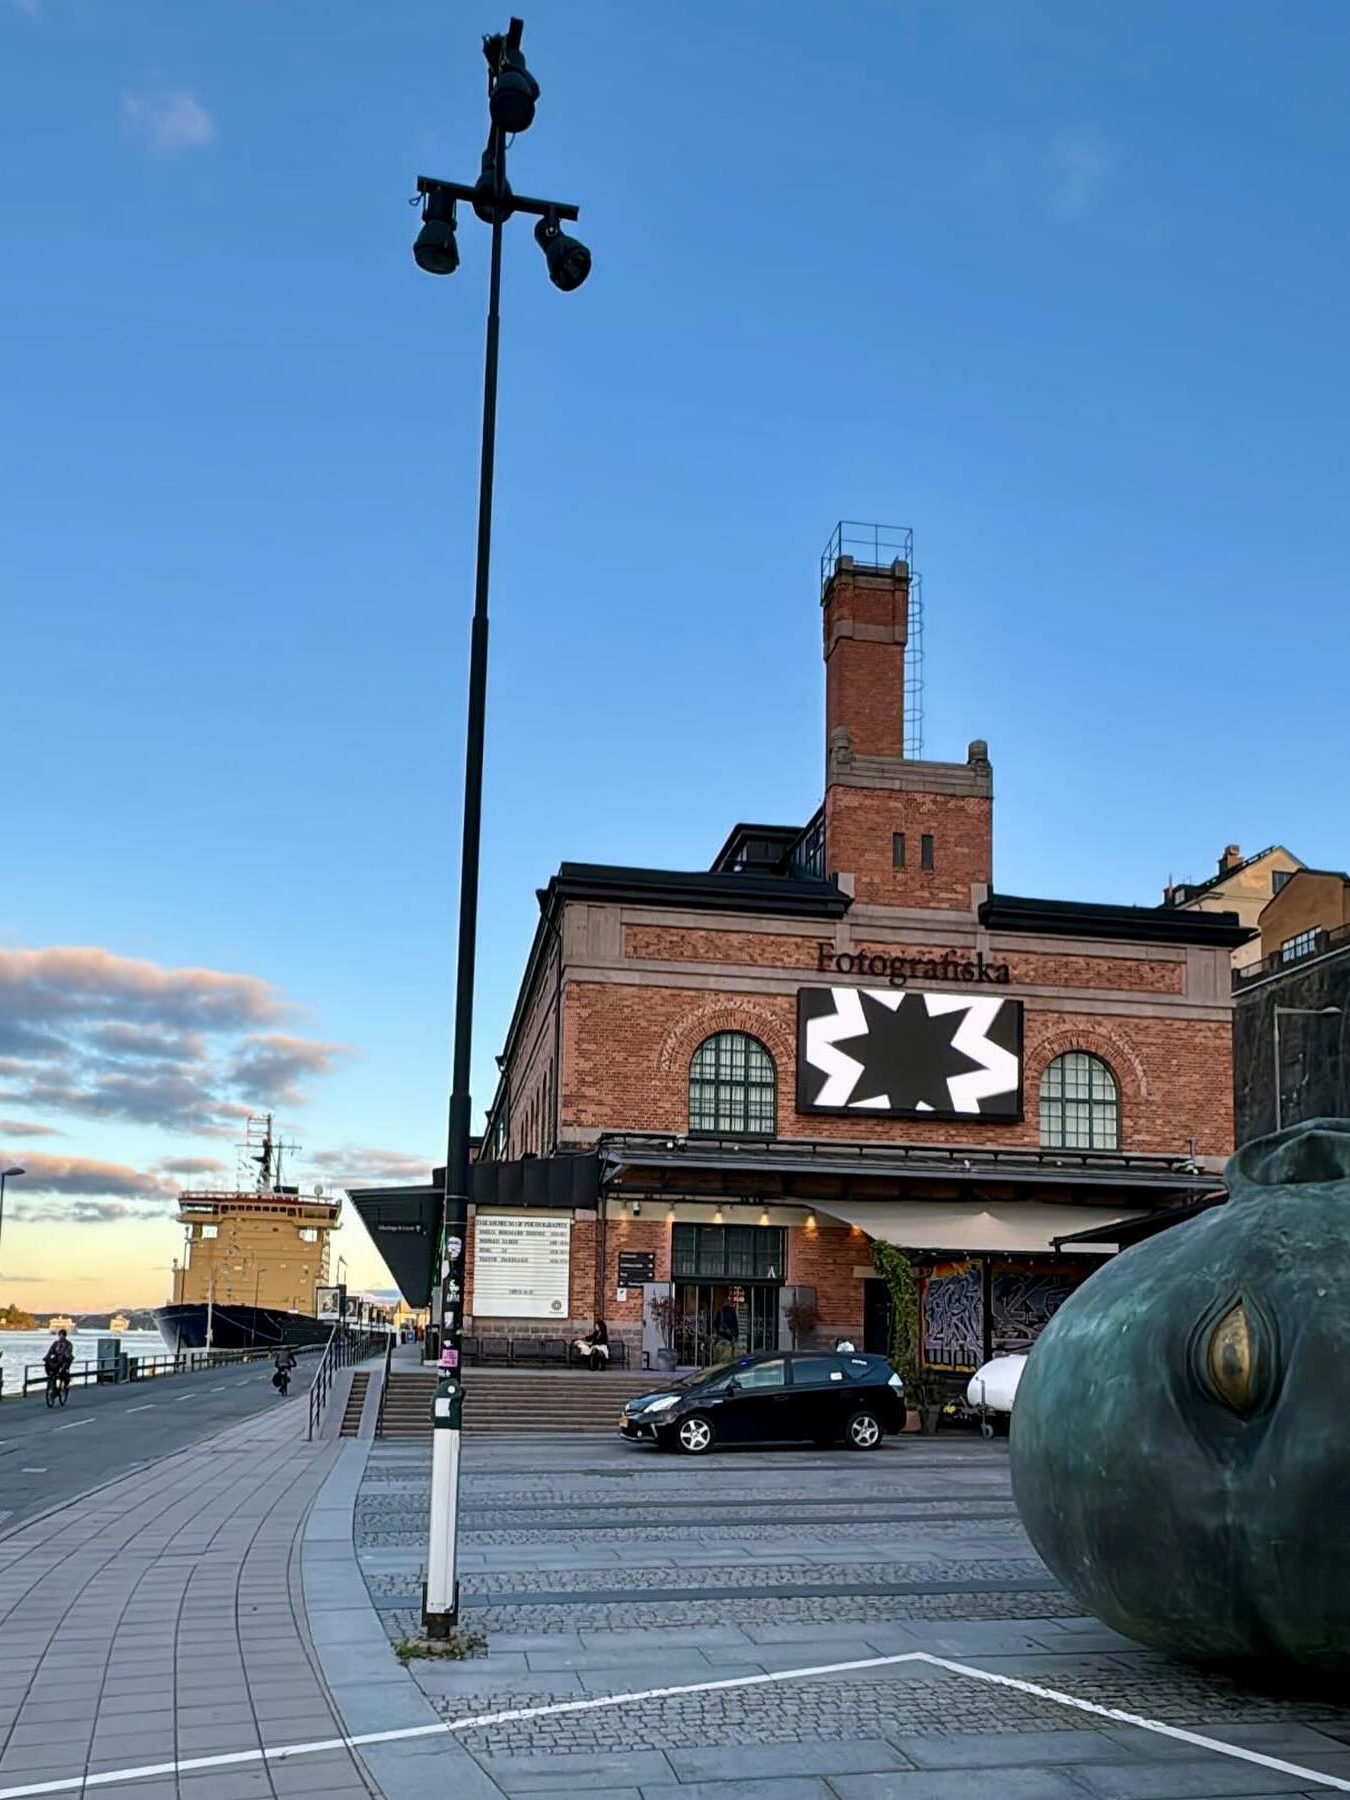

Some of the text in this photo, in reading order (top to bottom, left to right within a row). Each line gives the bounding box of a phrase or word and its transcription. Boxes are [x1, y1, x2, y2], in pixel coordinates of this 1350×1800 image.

[817, 942, 1010, 986] Fotografiska
[523, 1221, 567, 1229] PHOTOGRAPHY
[767, 1265, 776, 1278] A
